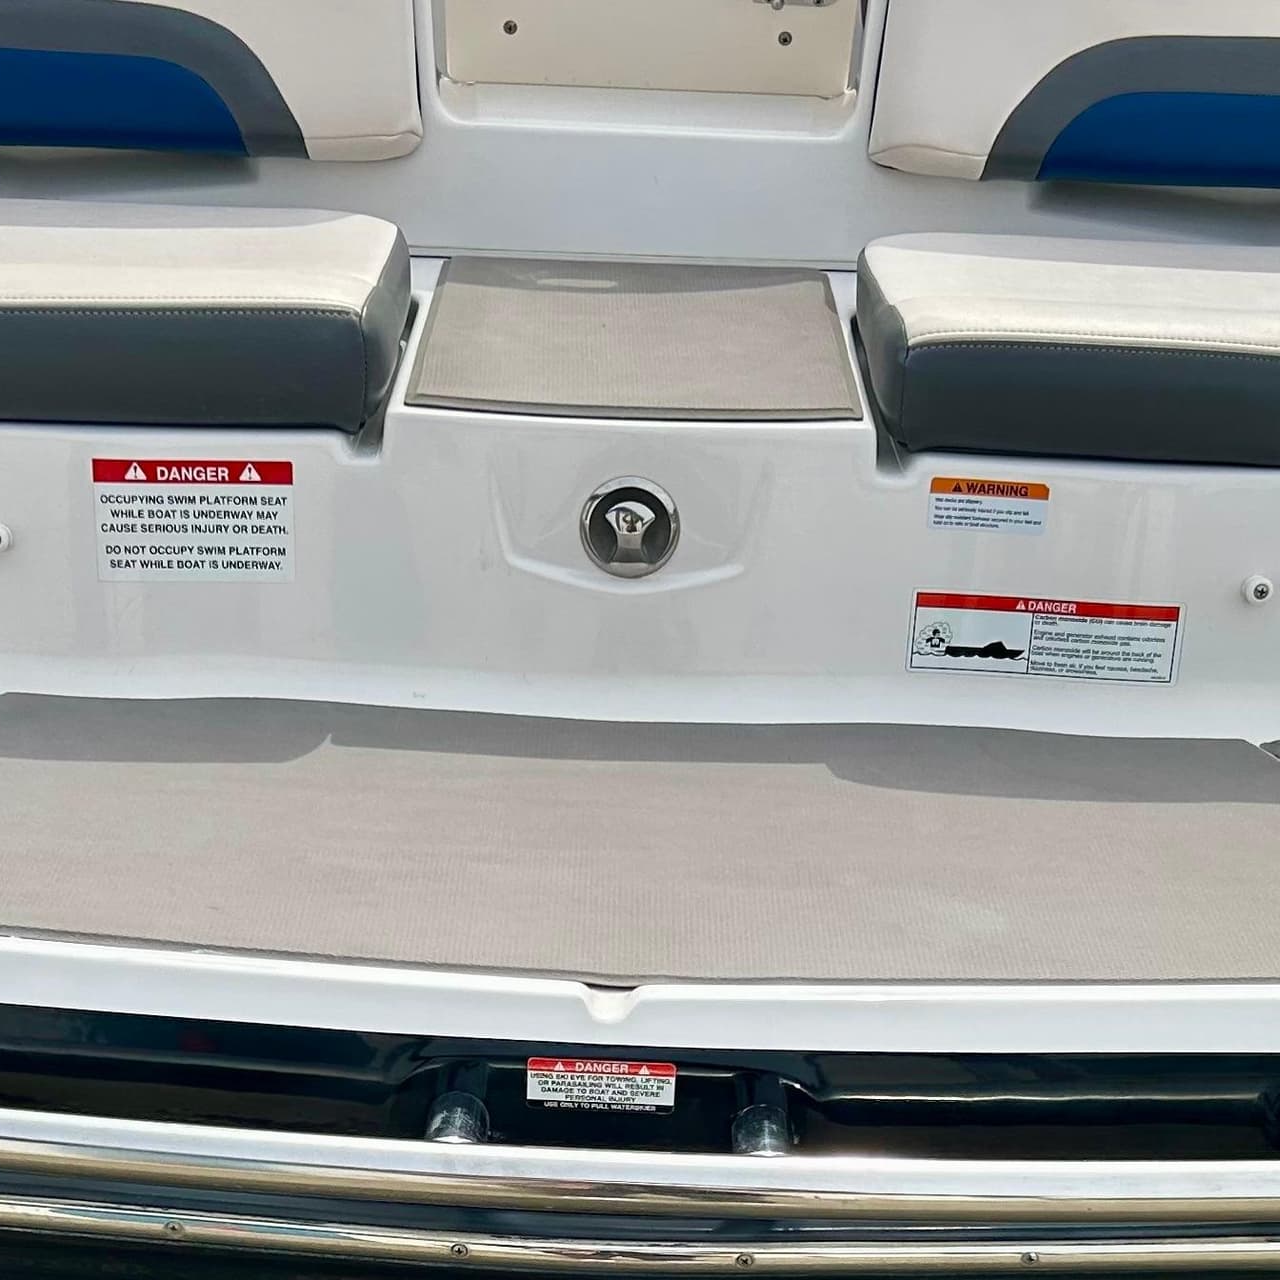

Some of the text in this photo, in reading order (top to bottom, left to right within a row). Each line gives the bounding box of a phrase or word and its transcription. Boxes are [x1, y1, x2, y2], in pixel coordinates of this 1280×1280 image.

[156, 466, 229, 481] DANGER
[966, 482, 1029, 497] WARNING
[100, 494, 287, 507] OCCUPYING SWIM PLATFORM SEAT
[110, 509, 278, 520] WHILE BOAT IS UNDERWAY MAY
[101, 523, 288, 535] CAUSE SERIOUS INJURY OR DEATH.
[105, 545, 287, 556] DO NOT OCCUPY SWIM PLATFORM
[110, 559, 283, 570] SEAT WHILE BOAT IS UNDERWAY.
[1028, 601, 1077, 614] DANGER
[575, 1062, 629, 1074] DANGER
